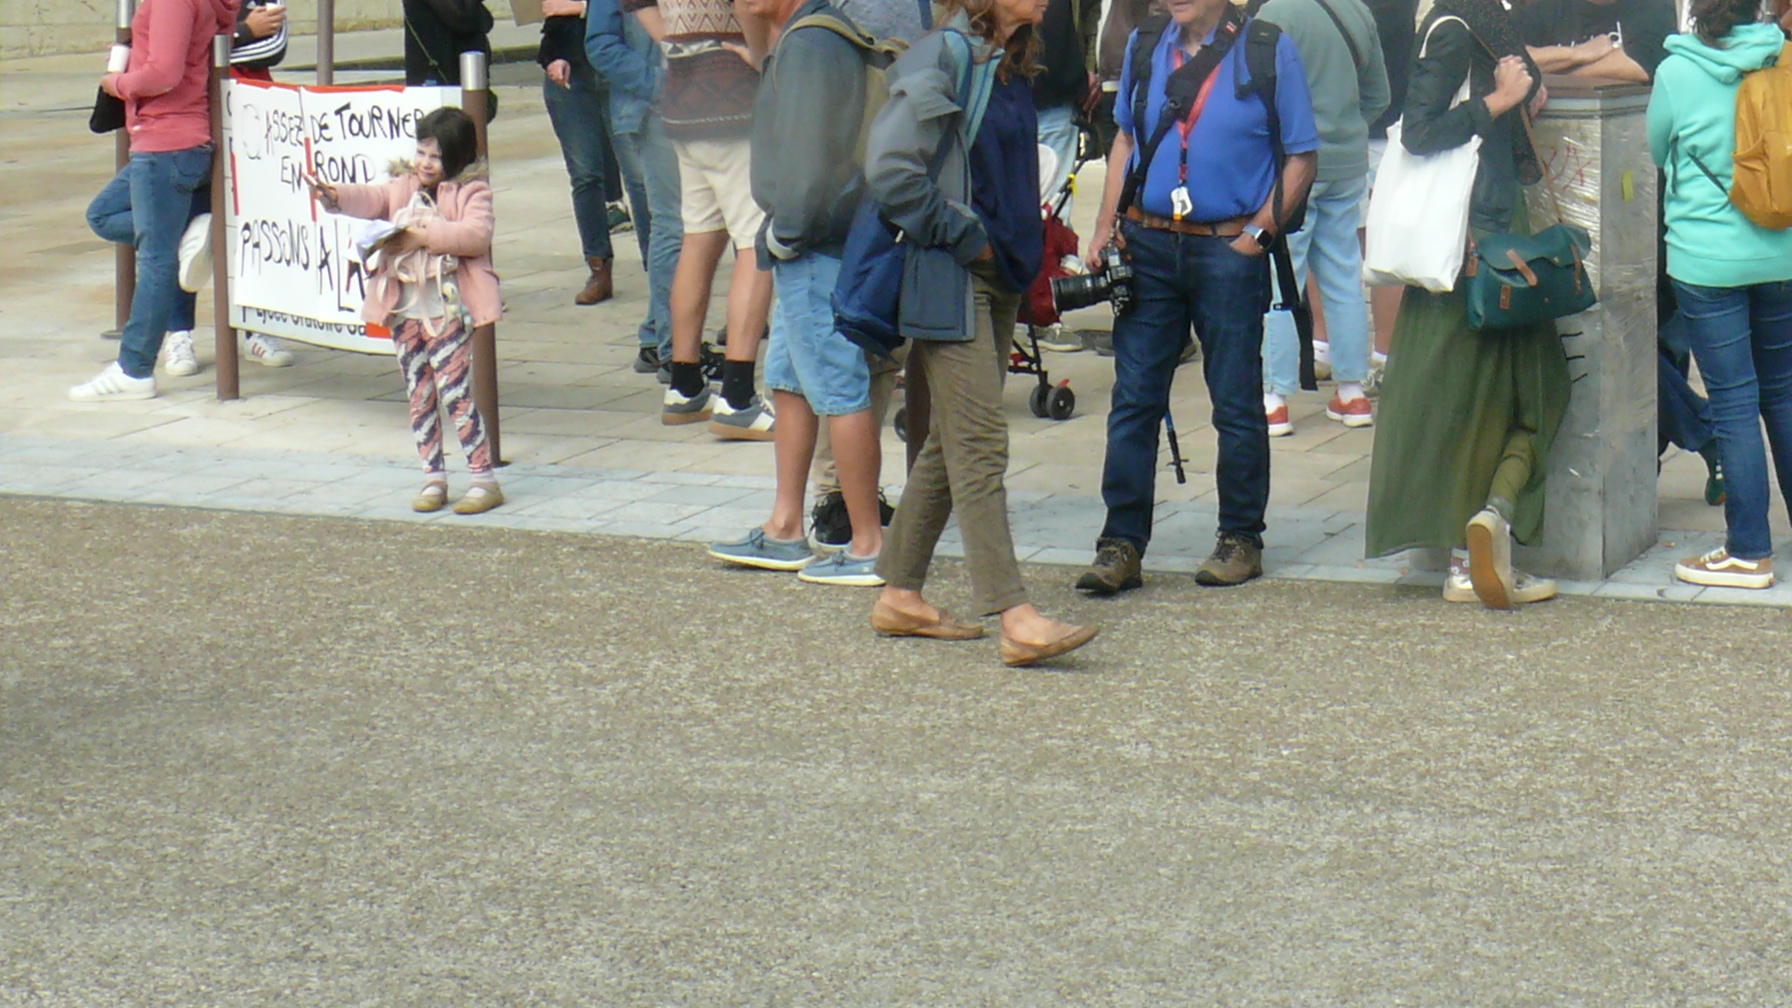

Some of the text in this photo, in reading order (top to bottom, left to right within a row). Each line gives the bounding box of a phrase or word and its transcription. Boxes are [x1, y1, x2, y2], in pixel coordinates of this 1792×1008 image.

[310, 111, 335, 145] DE
[281, 149, 377, 193] EN ROND
[240, 218, 311, 278] PASSONS
